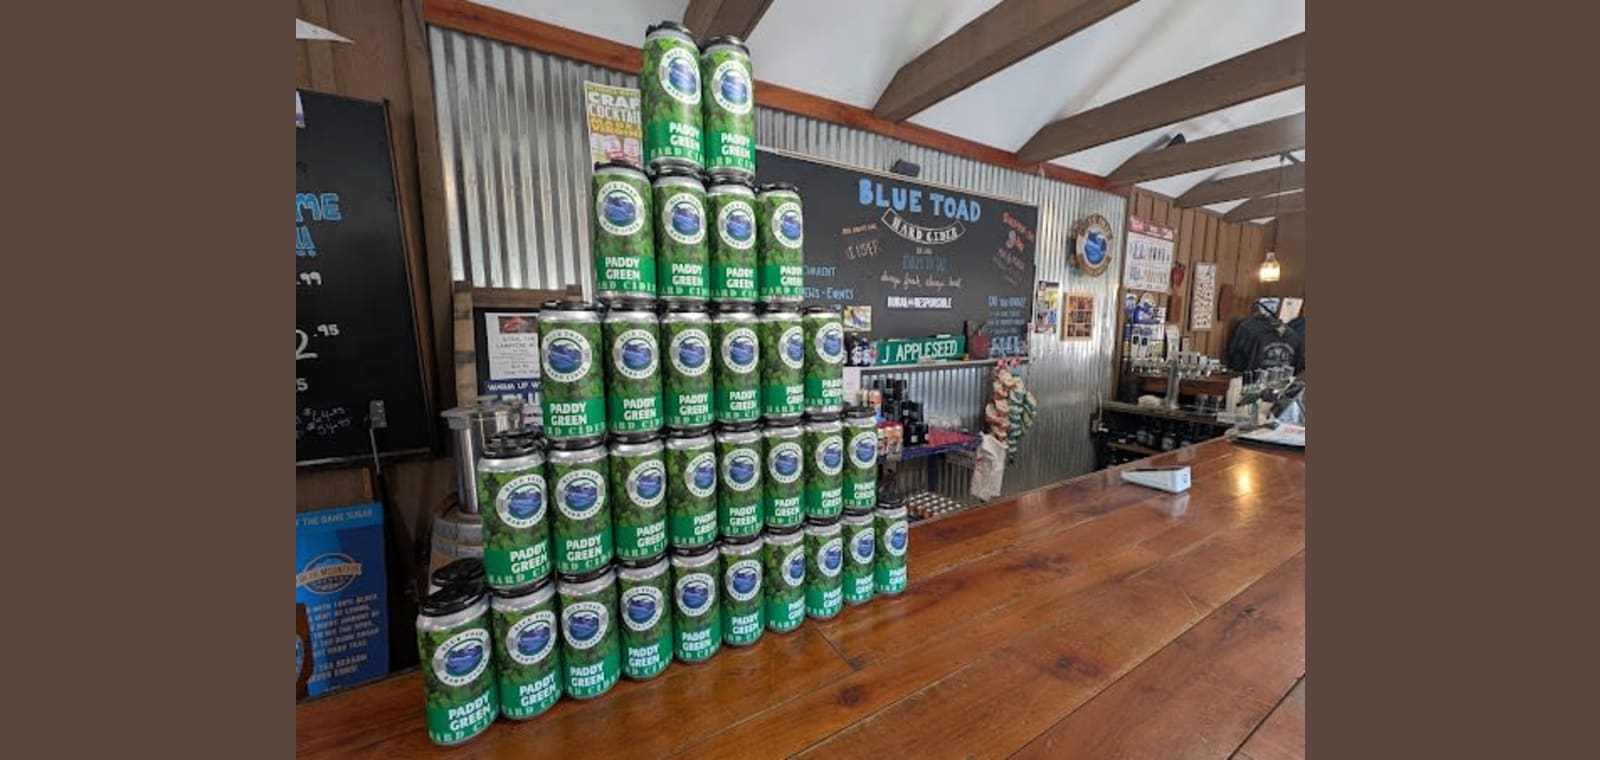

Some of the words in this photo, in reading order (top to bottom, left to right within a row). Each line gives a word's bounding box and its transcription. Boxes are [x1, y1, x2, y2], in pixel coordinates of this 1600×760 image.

[590, 104, 641, 124] COCKTAI
[669, 122, 699, 139] PADDY
[670, 135, 699, 151] GREEN
[721, 133, 750, 147] PADDY
[721, 145, 750, 159] GREEN
[858, 177, 922, 213] BLUE
[929, 192, 982, 222] TOAD
[891, 215, 922, 241] HARD
[925, 226, 959, 242] CIDER
[604, 256, 640, 268] PADDY
[672, 263, 702, 275] PADDY
[605, 269, 641, 280] GREEN
[726, 267, 754, 278] PADDY
[780, 265, 803, 276] PADD
[672, 275, 703, 287] GREEN
[726, 278, 754, 288] GREEN
[780, 276, 803, 287] GREE
[881, 345, 890, 363] J
[895, 339, 958, 362] APPLESEED
[488, 382, 515, 392] WARM
[517, 382, 529, 390] UP
[623, 396, 655, 409] PADDY
[679, 393, 708, 405] PADDY
[729, 390, 756, 401] PADDY
[549, 401, 586, 415] PADDY
[679, 404, 708, 416] GREEN
[729, 400, 757, 411] GREEN
[550, 413, 587, 426] GREEN
[624, 408, 656, 420] GREEN
[774, 497, 799, 508] PADDY
[728, 506, 756, 517] PADDY
[774, 506, 799, 517] GREEN
[636, 519, 665, 537] PADDY
[728, 516, 757, 527] GREEN
[566, 534, 602, 550] PADDY
[637, 531, 665, 548] GREEN
[510, 541, 547, 562] PADDY
[567, 545, 602, 562] GREEN
[511, 552, 547, 574] GREEN
[731, 612, 758, 626] PADDY
[681, 628, 711, 642] PADDY
[732, 622, 759, 635] GREEN
[628, 643, 659, 657] PADDY
[681, 639, 711, 652] GREEN
[628, 654, 660, 668] GREEN
[570, 660, 604, 677] PADDY
[518, 671, 555, 697] PADDY
[571, 672, 605, 688] GREEN
[520, 683, 556, 706] GREEN
[448, 690, 489, 720] PADDY
[450, 703, 490, 731] GREEN
